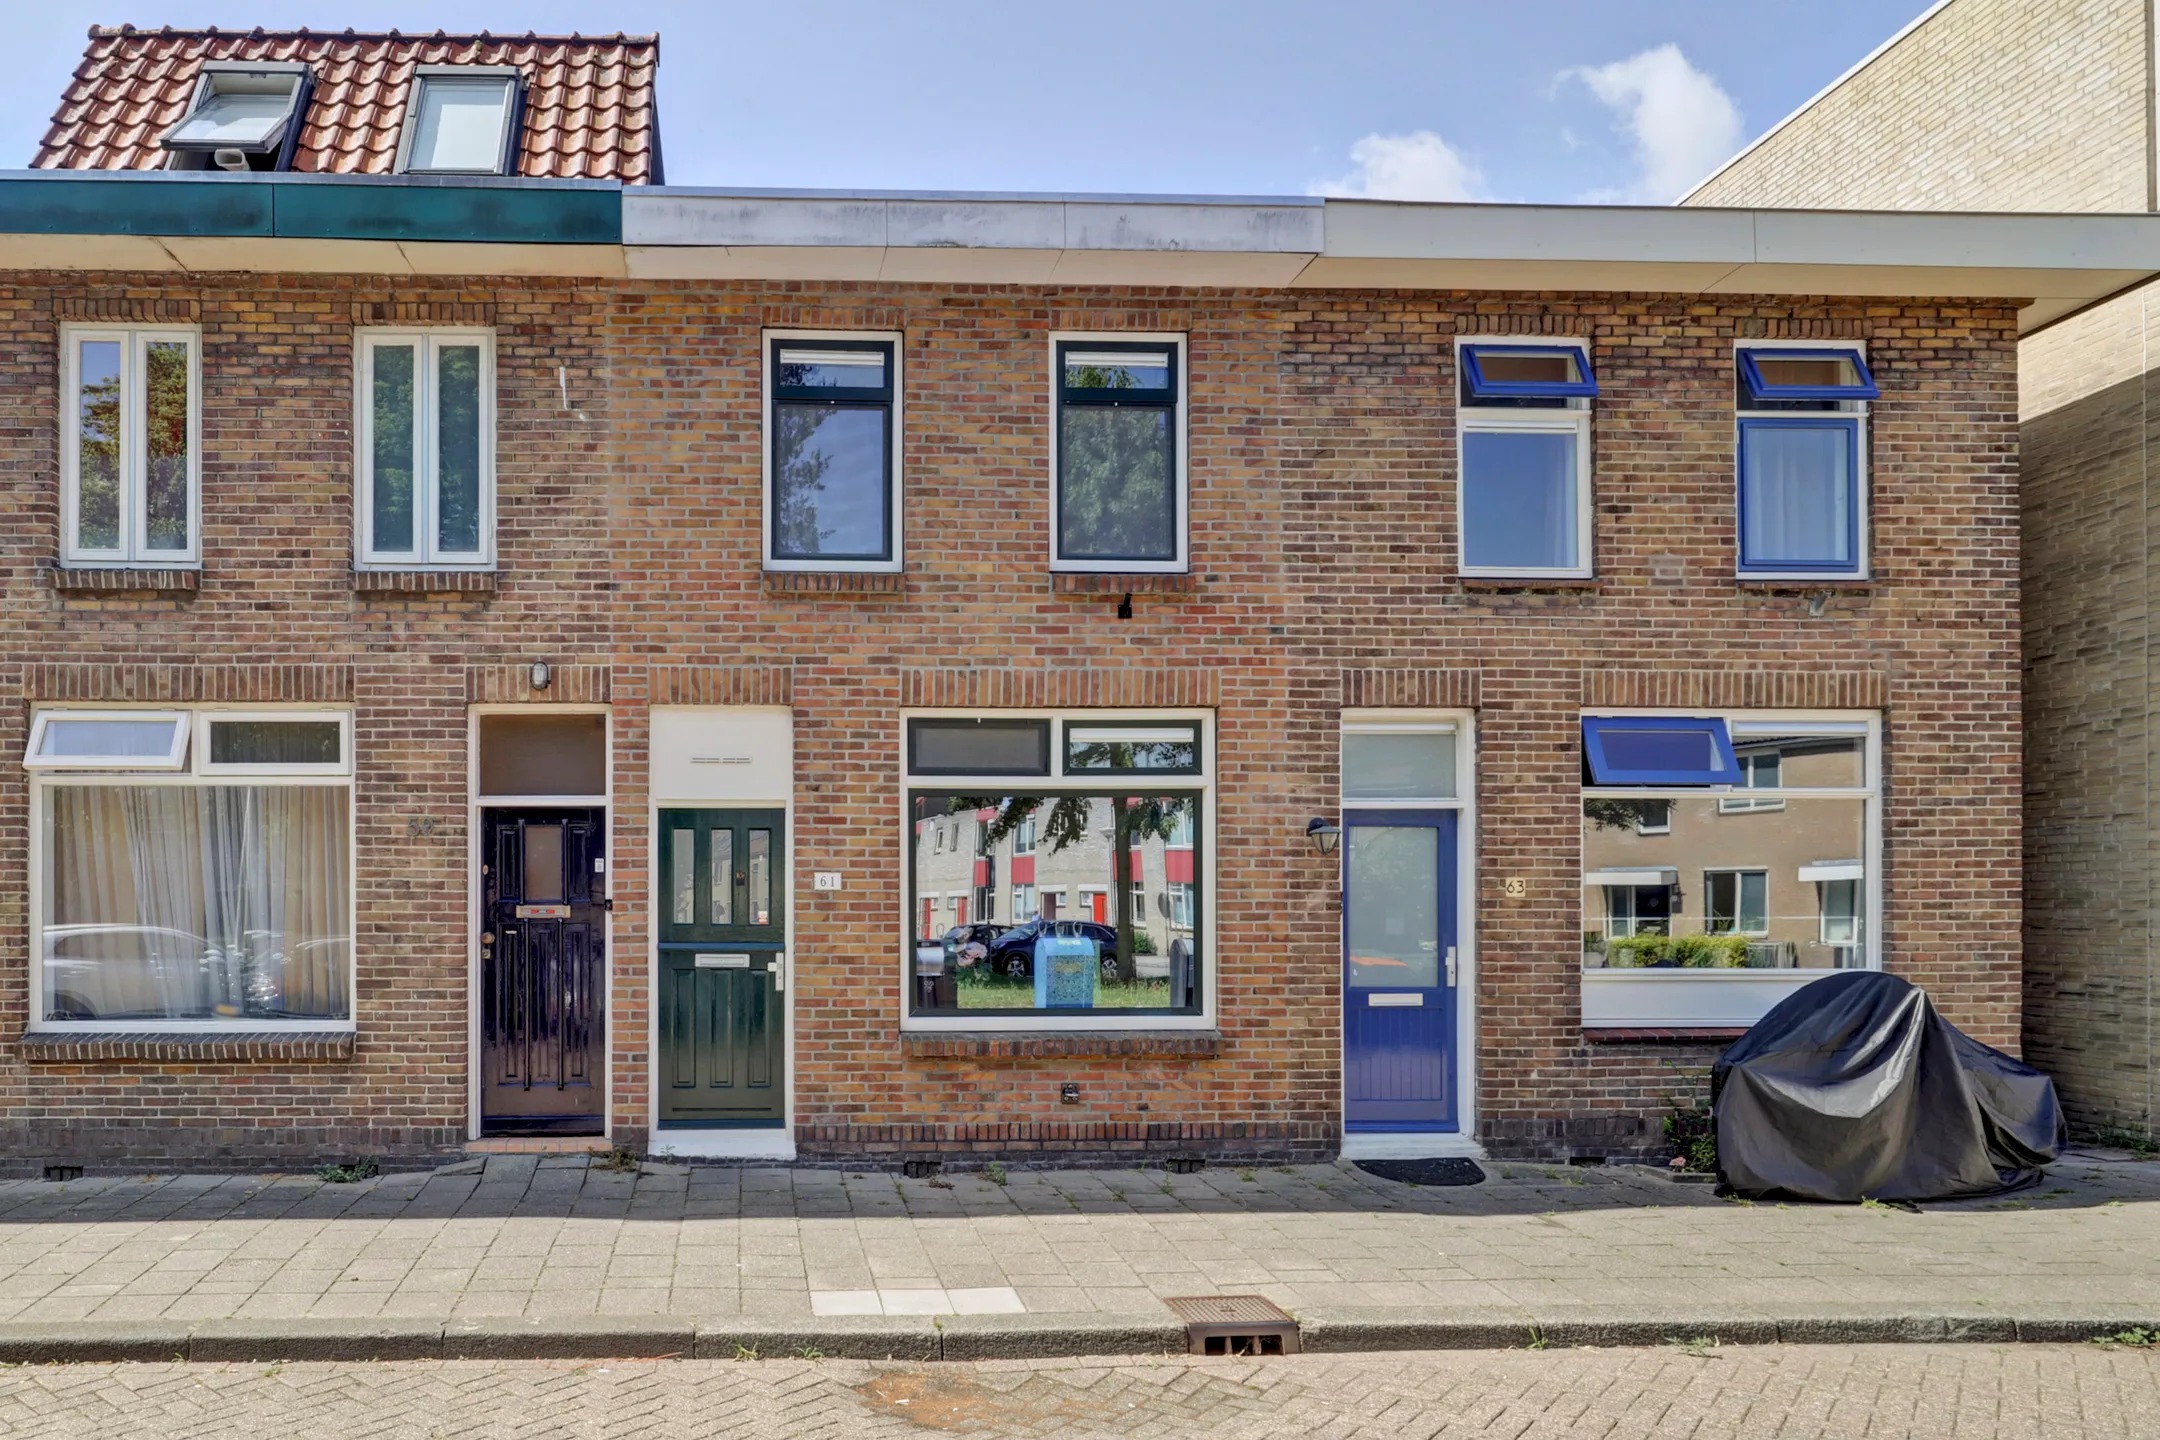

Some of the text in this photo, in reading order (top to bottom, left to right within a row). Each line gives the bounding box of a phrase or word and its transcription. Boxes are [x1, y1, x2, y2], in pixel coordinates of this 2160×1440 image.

[407, 816, 434, 837] 59
[820, 875, 835, 888] 61
[1506, 880, 1525, 894] 63
